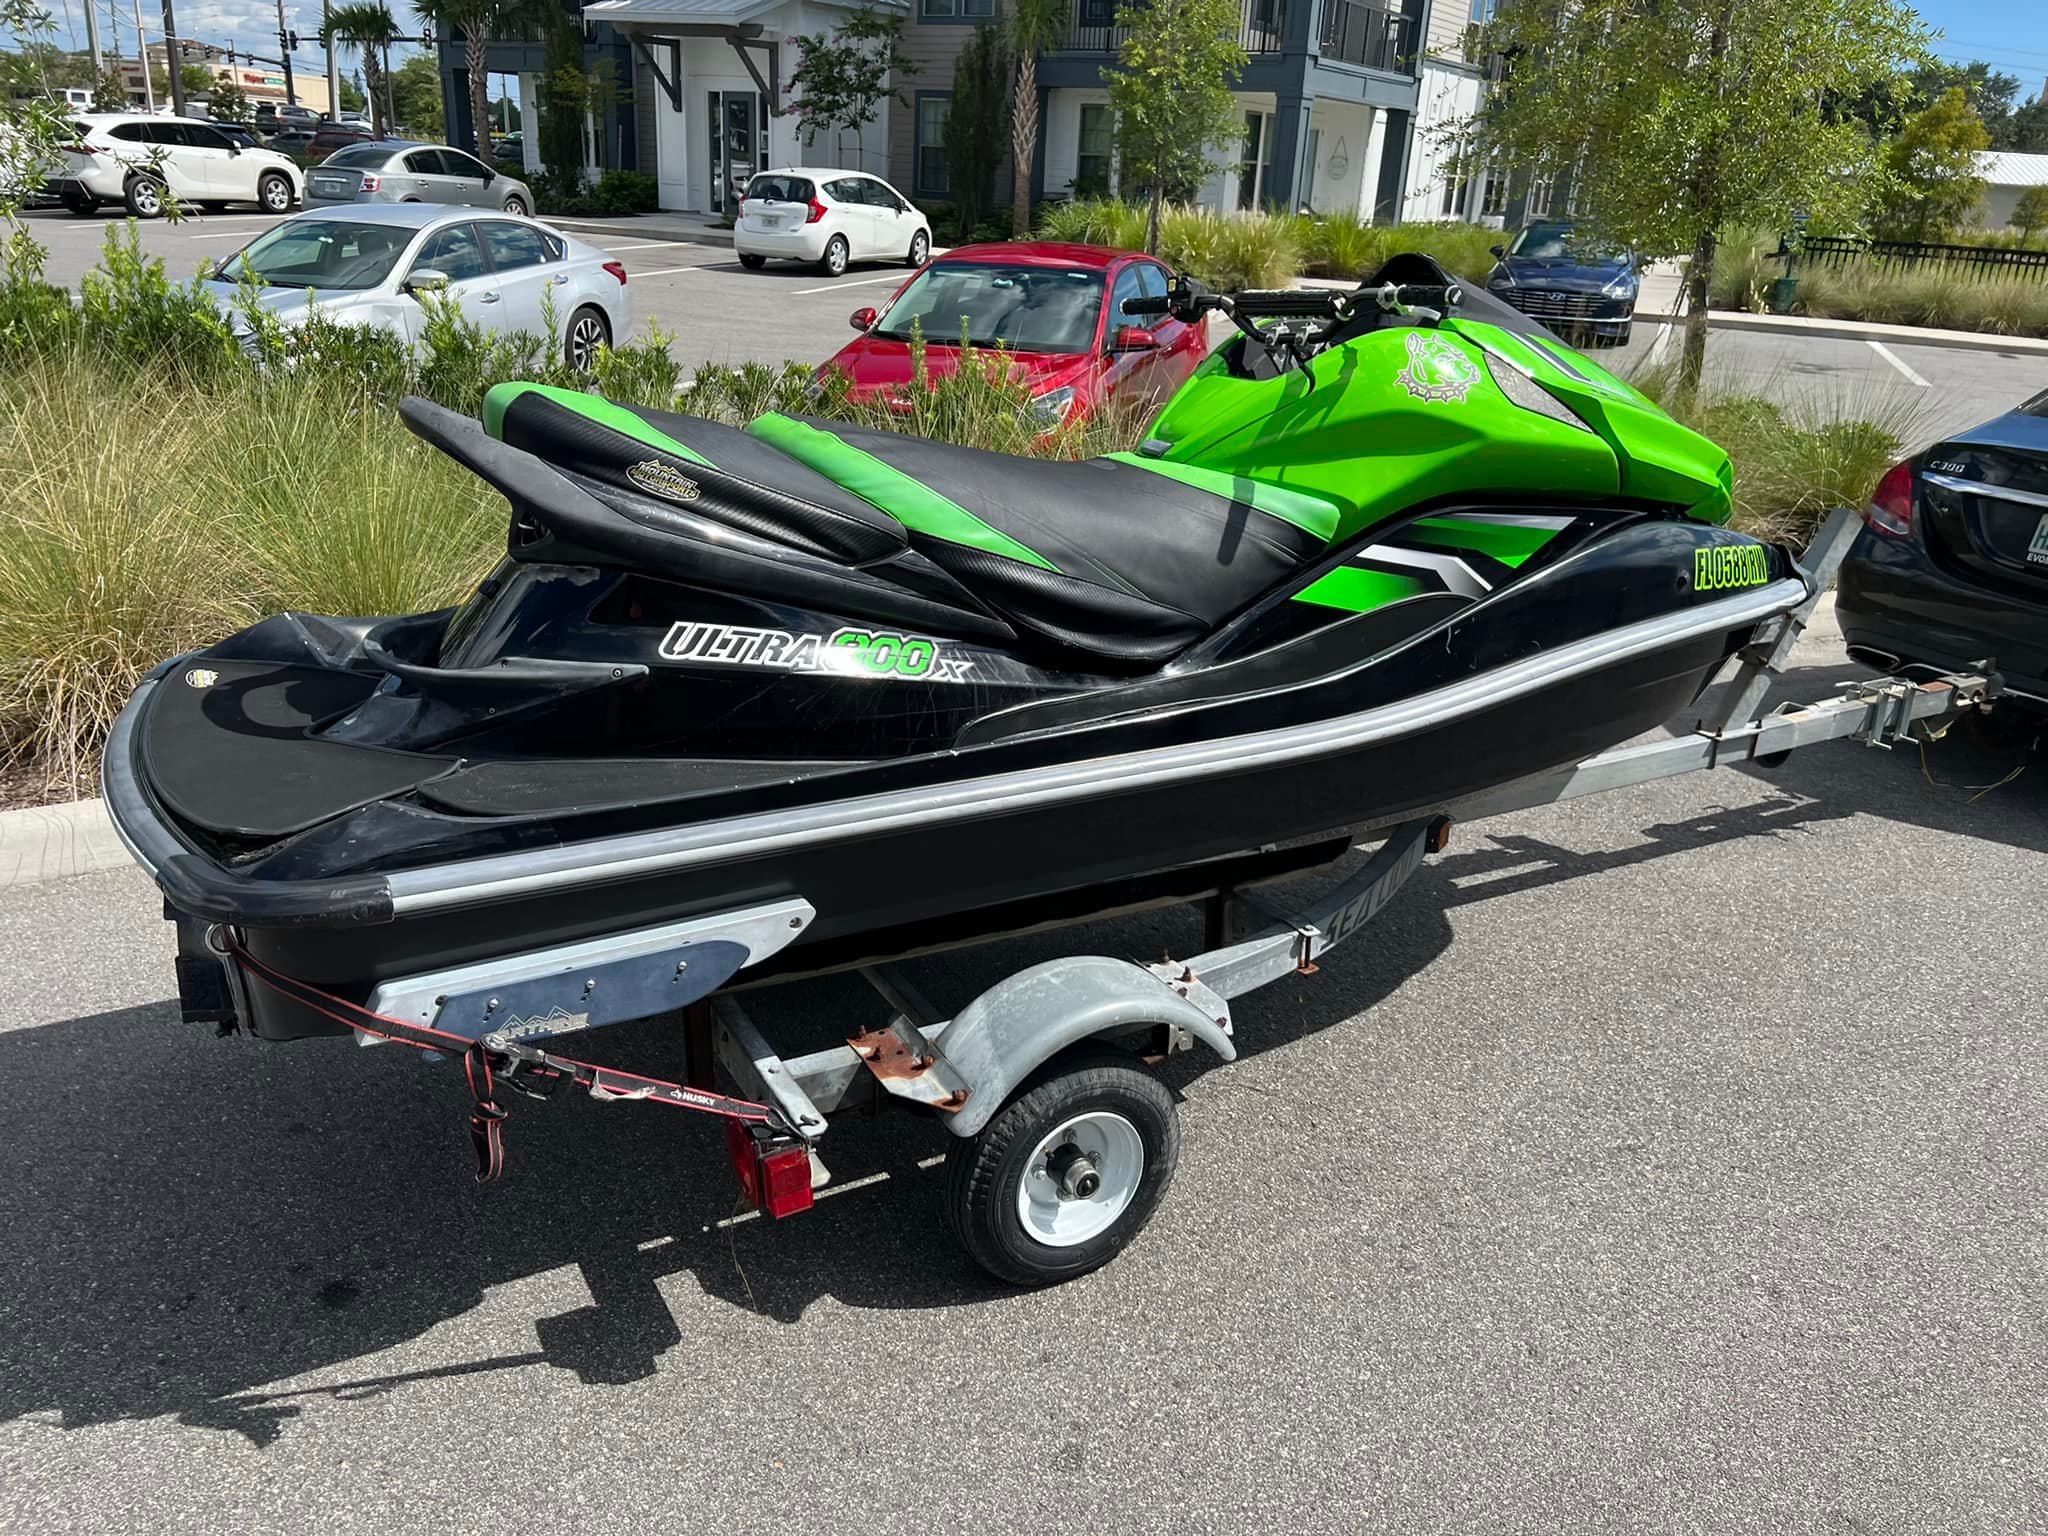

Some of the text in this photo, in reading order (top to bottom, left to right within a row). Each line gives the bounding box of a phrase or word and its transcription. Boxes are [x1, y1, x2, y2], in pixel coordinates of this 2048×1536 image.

[639, 464, 695, 489] MOUNTAIN
[660, 622, 822, 668] ULTRA
[682, 1090, 716, 1106] HUSKY
